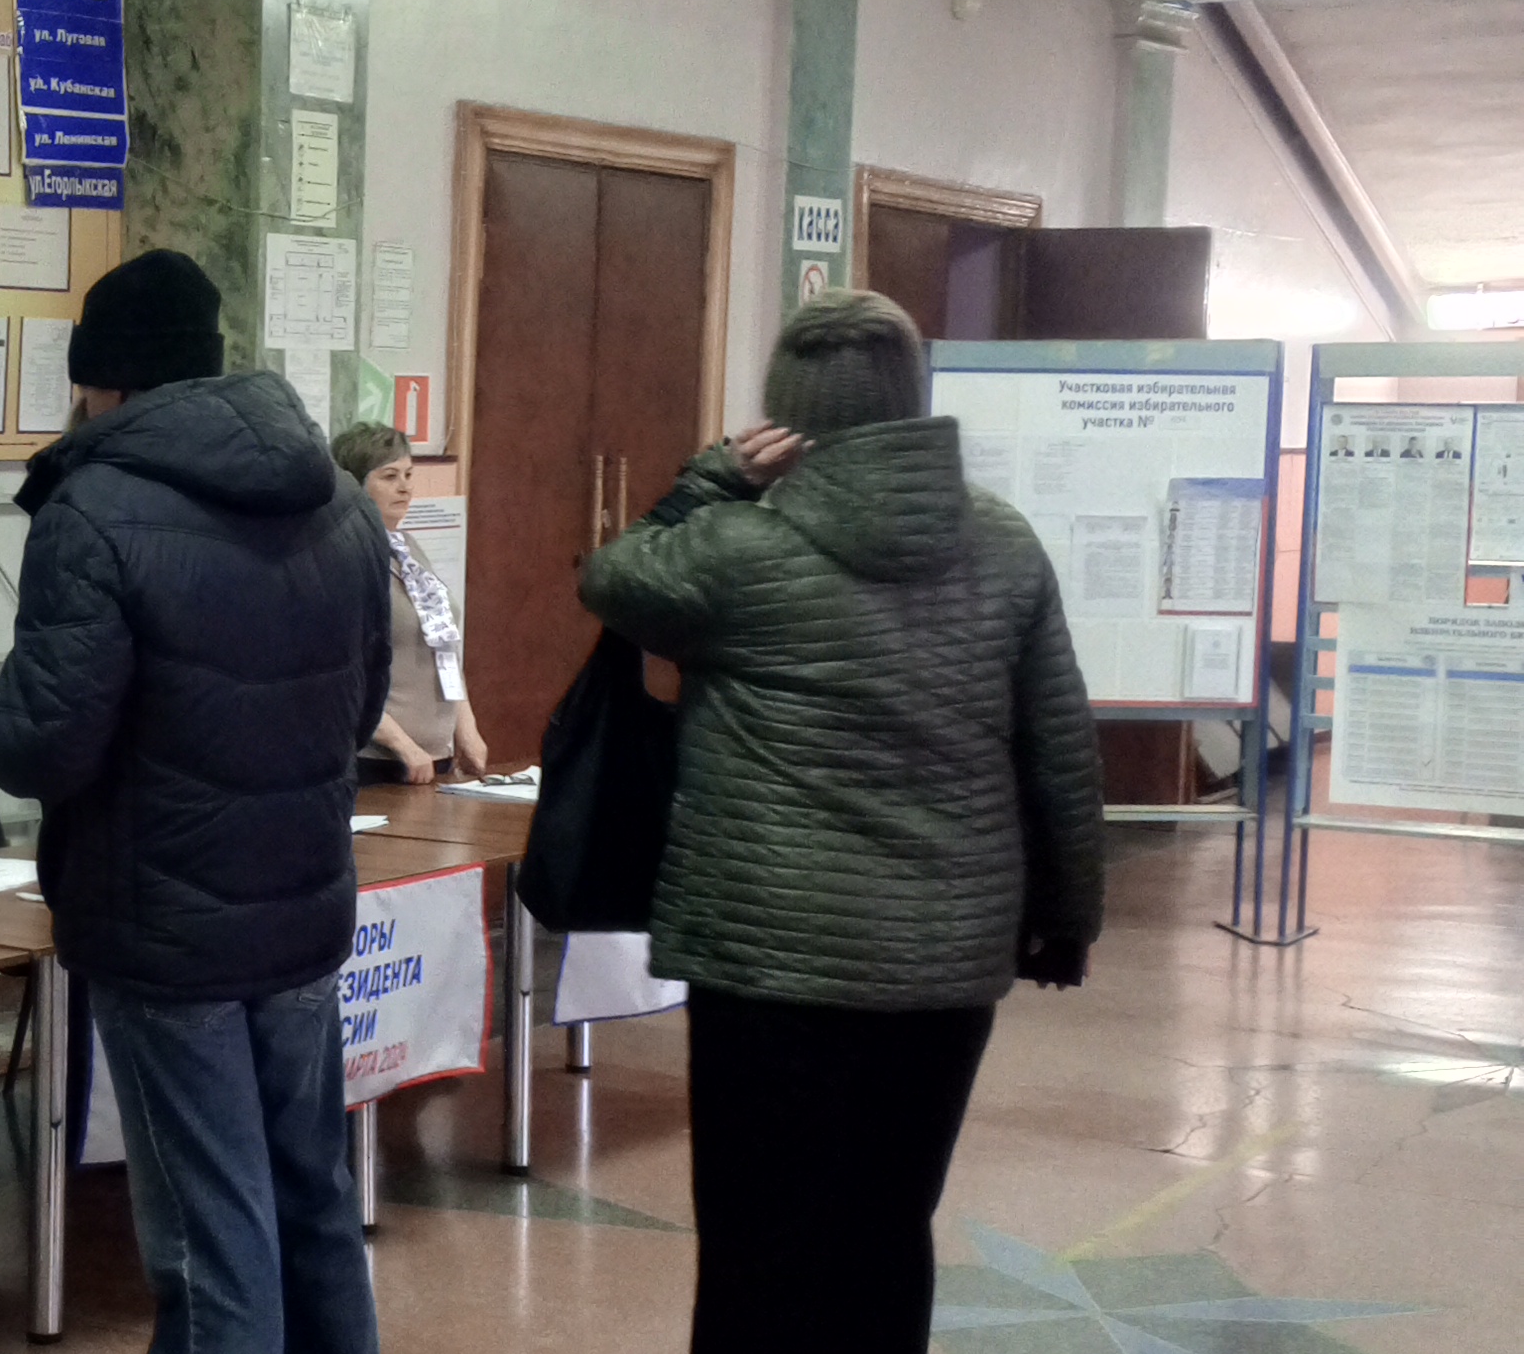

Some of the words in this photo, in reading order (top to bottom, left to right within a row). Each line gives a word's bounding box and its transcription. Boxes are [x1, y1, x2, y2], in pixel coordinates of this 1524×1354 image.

[34, 28, 52, 43] ул.
[56, 29, 105, 47] Луговая
[29, 76, 47, 92] ул.
[51, 78, 114, 97] Кубанская
[35, 133, 51, 146] ул.
[55, 132, 117, 147] Ленинская
[1059, 380, 1133, 394] Участковая
[1137, 381, 1236, 396] избирательная
[1062, 399, 1125, 411] комиссия
[1129, 398, 1235, 413] избирательного
[1082, 417, 1133, 429] участка
[1138, 416, 1155, 428] №
[342, 1009, 377, 1048] СИИ
